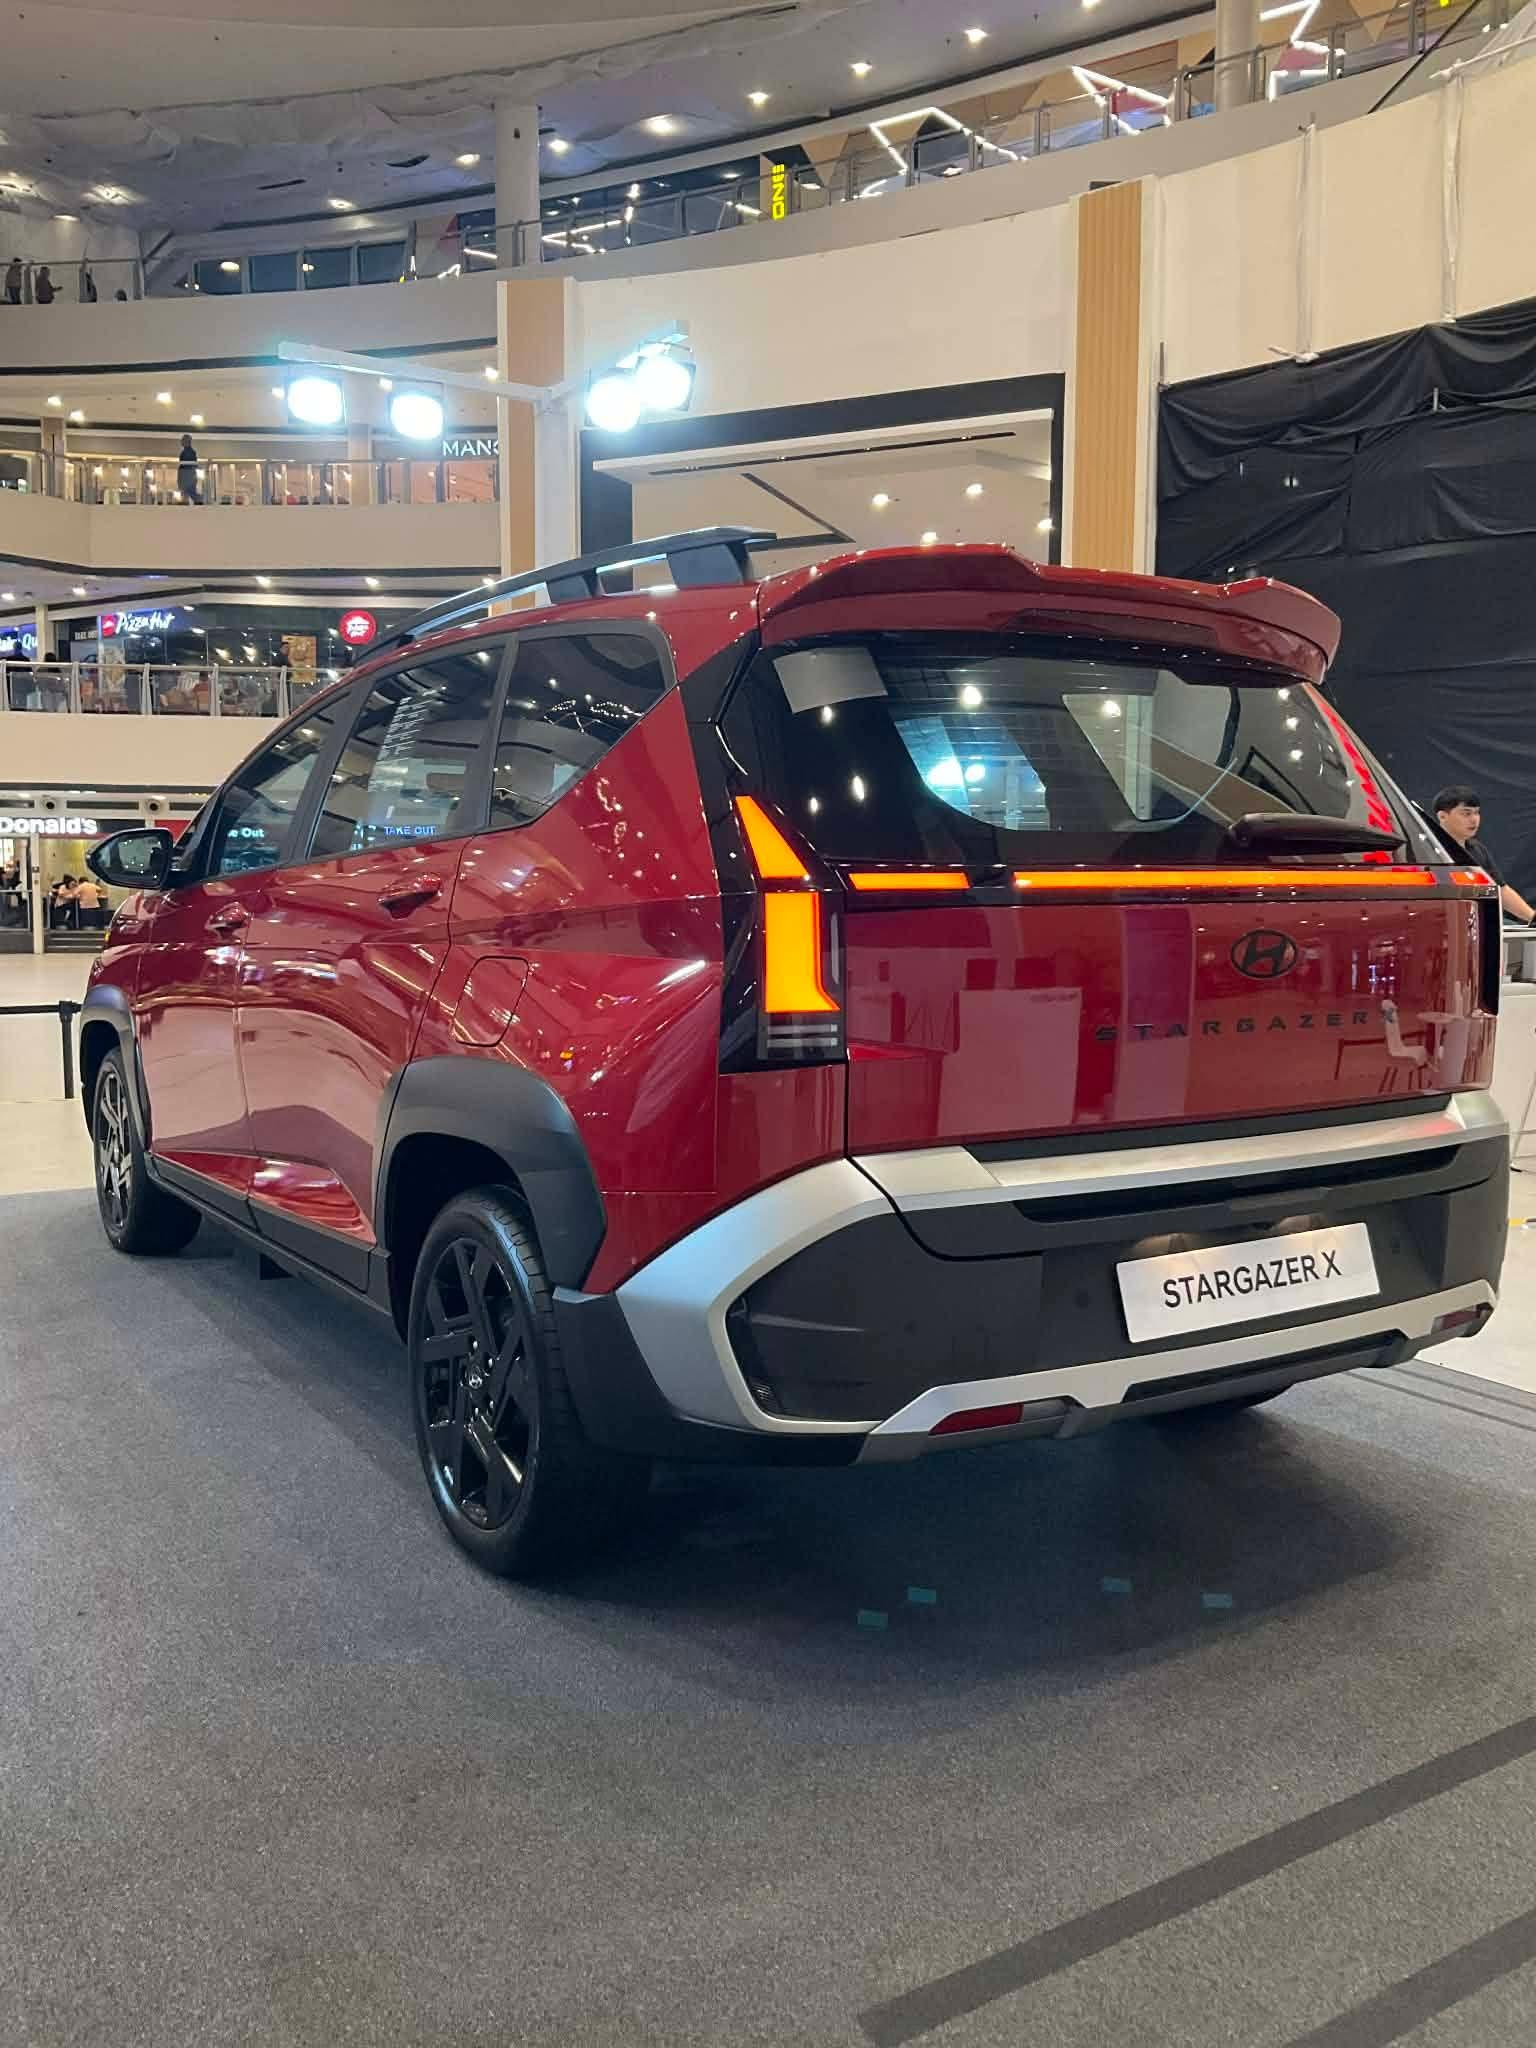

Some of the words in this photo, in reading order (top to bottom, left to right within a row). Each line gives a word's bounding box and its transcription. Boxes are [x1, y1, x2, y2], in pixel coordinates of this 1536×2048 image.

[115, 612, 148, 634] Pizza
[149, 611, 175, 630] Hut
[0, 816, 98, 834] Donald's
[241, 827, 264, 838] Out
[384, 826, 411, 835] TAKE
[414, 825, 436, 835] OUT
[1163, 1254, 1319, 1308] STARGAZER
[1321, 1250, 1342, 1278] X
